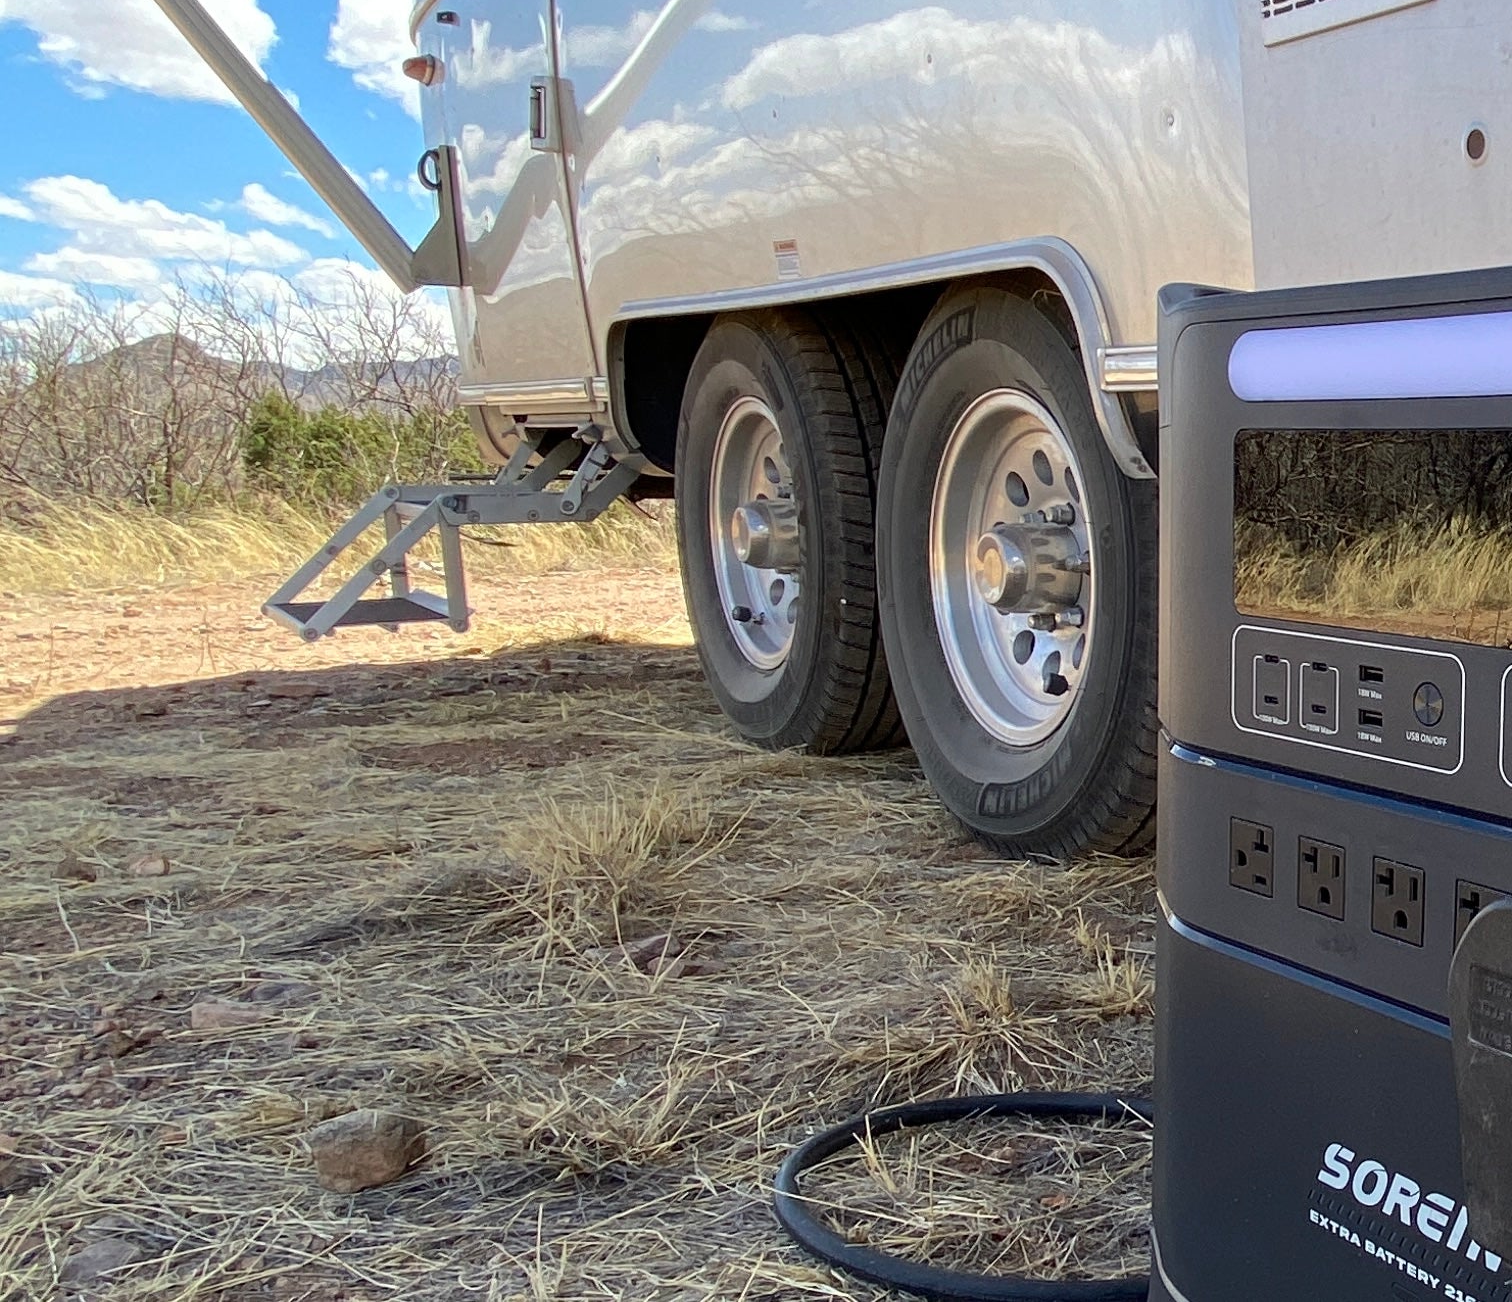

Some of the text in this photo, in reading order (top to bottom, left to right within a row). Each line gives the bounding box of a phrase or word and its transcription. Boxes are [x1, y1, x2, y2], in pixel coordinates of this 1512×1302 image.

[1405, 731, 1448, 746] USB ON/OFF
[1309, 1209, 1363, 1248] EXTRA
[1364, 1239, 1441, 1290] BATTERY
